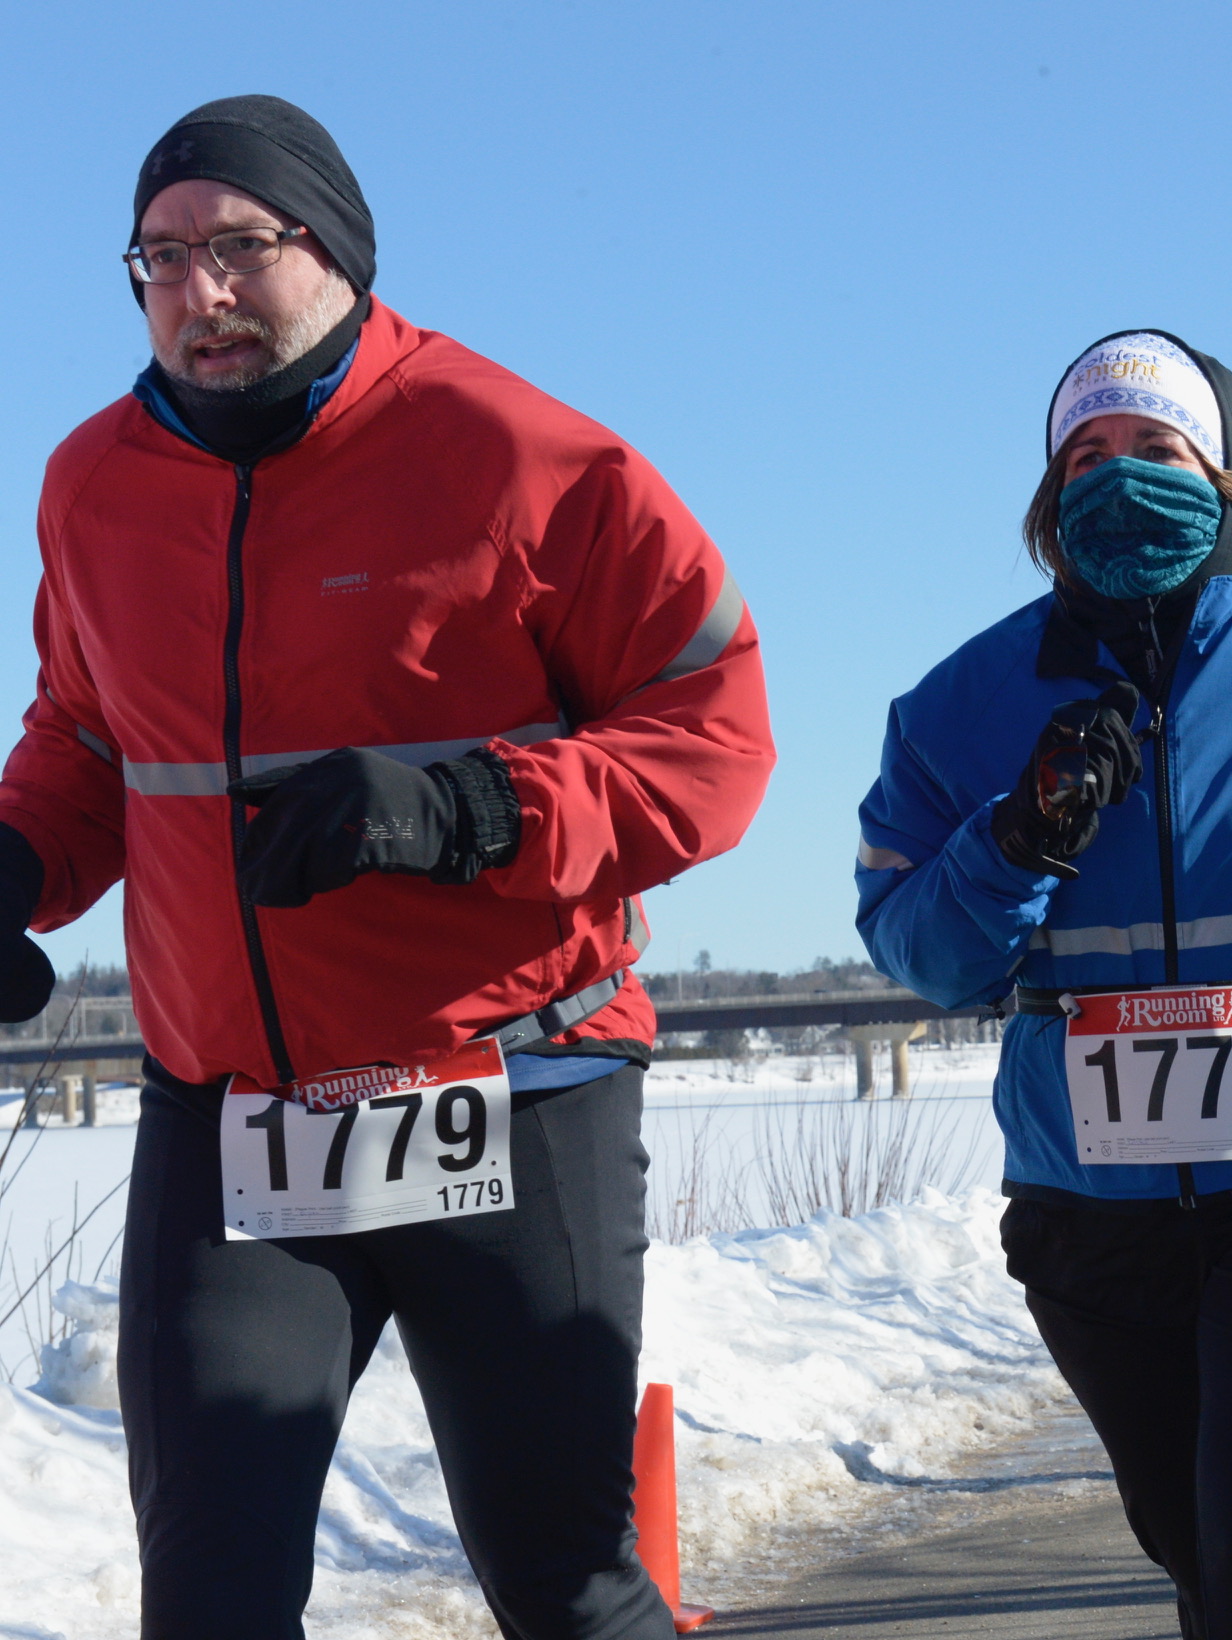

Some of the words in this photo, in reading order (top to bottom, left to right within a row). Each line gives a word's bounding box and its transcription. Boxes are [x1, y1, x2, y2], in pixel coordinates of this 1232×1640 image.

[1086, 359, 1161, 381] night
[1132, 991, 1226, 1026] Running
[304, 1066, 412, 1110] Running
[304, 1082, 392, 1110] Room
[246, 1085, 487, 1191] 1779
[437, 1178, 503, 1212] 1779
